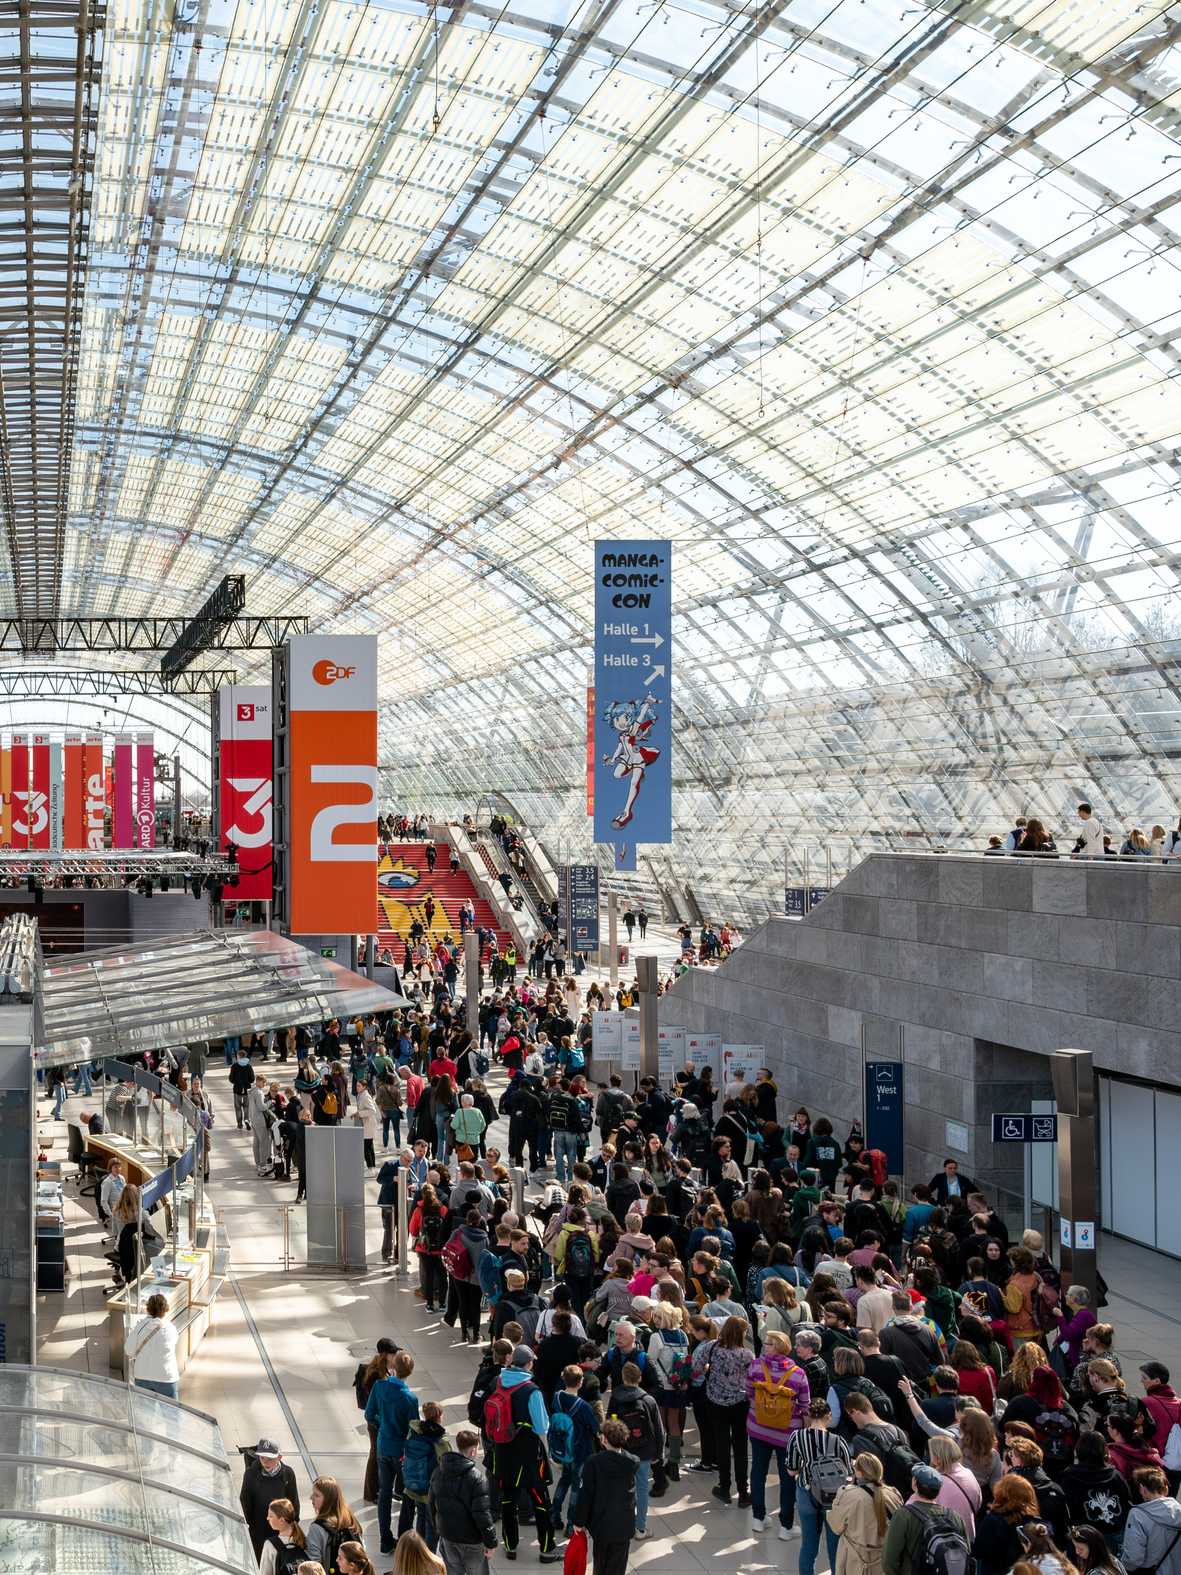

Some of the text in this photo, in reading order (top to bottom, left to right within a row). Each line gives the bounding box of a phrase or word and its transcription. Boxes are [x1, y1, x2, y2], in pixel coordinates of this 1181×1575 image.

[602, 554, 664, 567] MANGA-
[612, 594, 651, 608] CON
[604, 623, 649, 635] Halle 1
[604, 654, 651, 666] Halle 3
[141, 777, 150, 808] Kultur
[86, 774, 104, 849] arte
[310, 765, 377, 861] 2
[141, 825, 150, 848] ARD
[876, 1085, 897, 1094] West
[877, 1094, 880, 1102] 1
